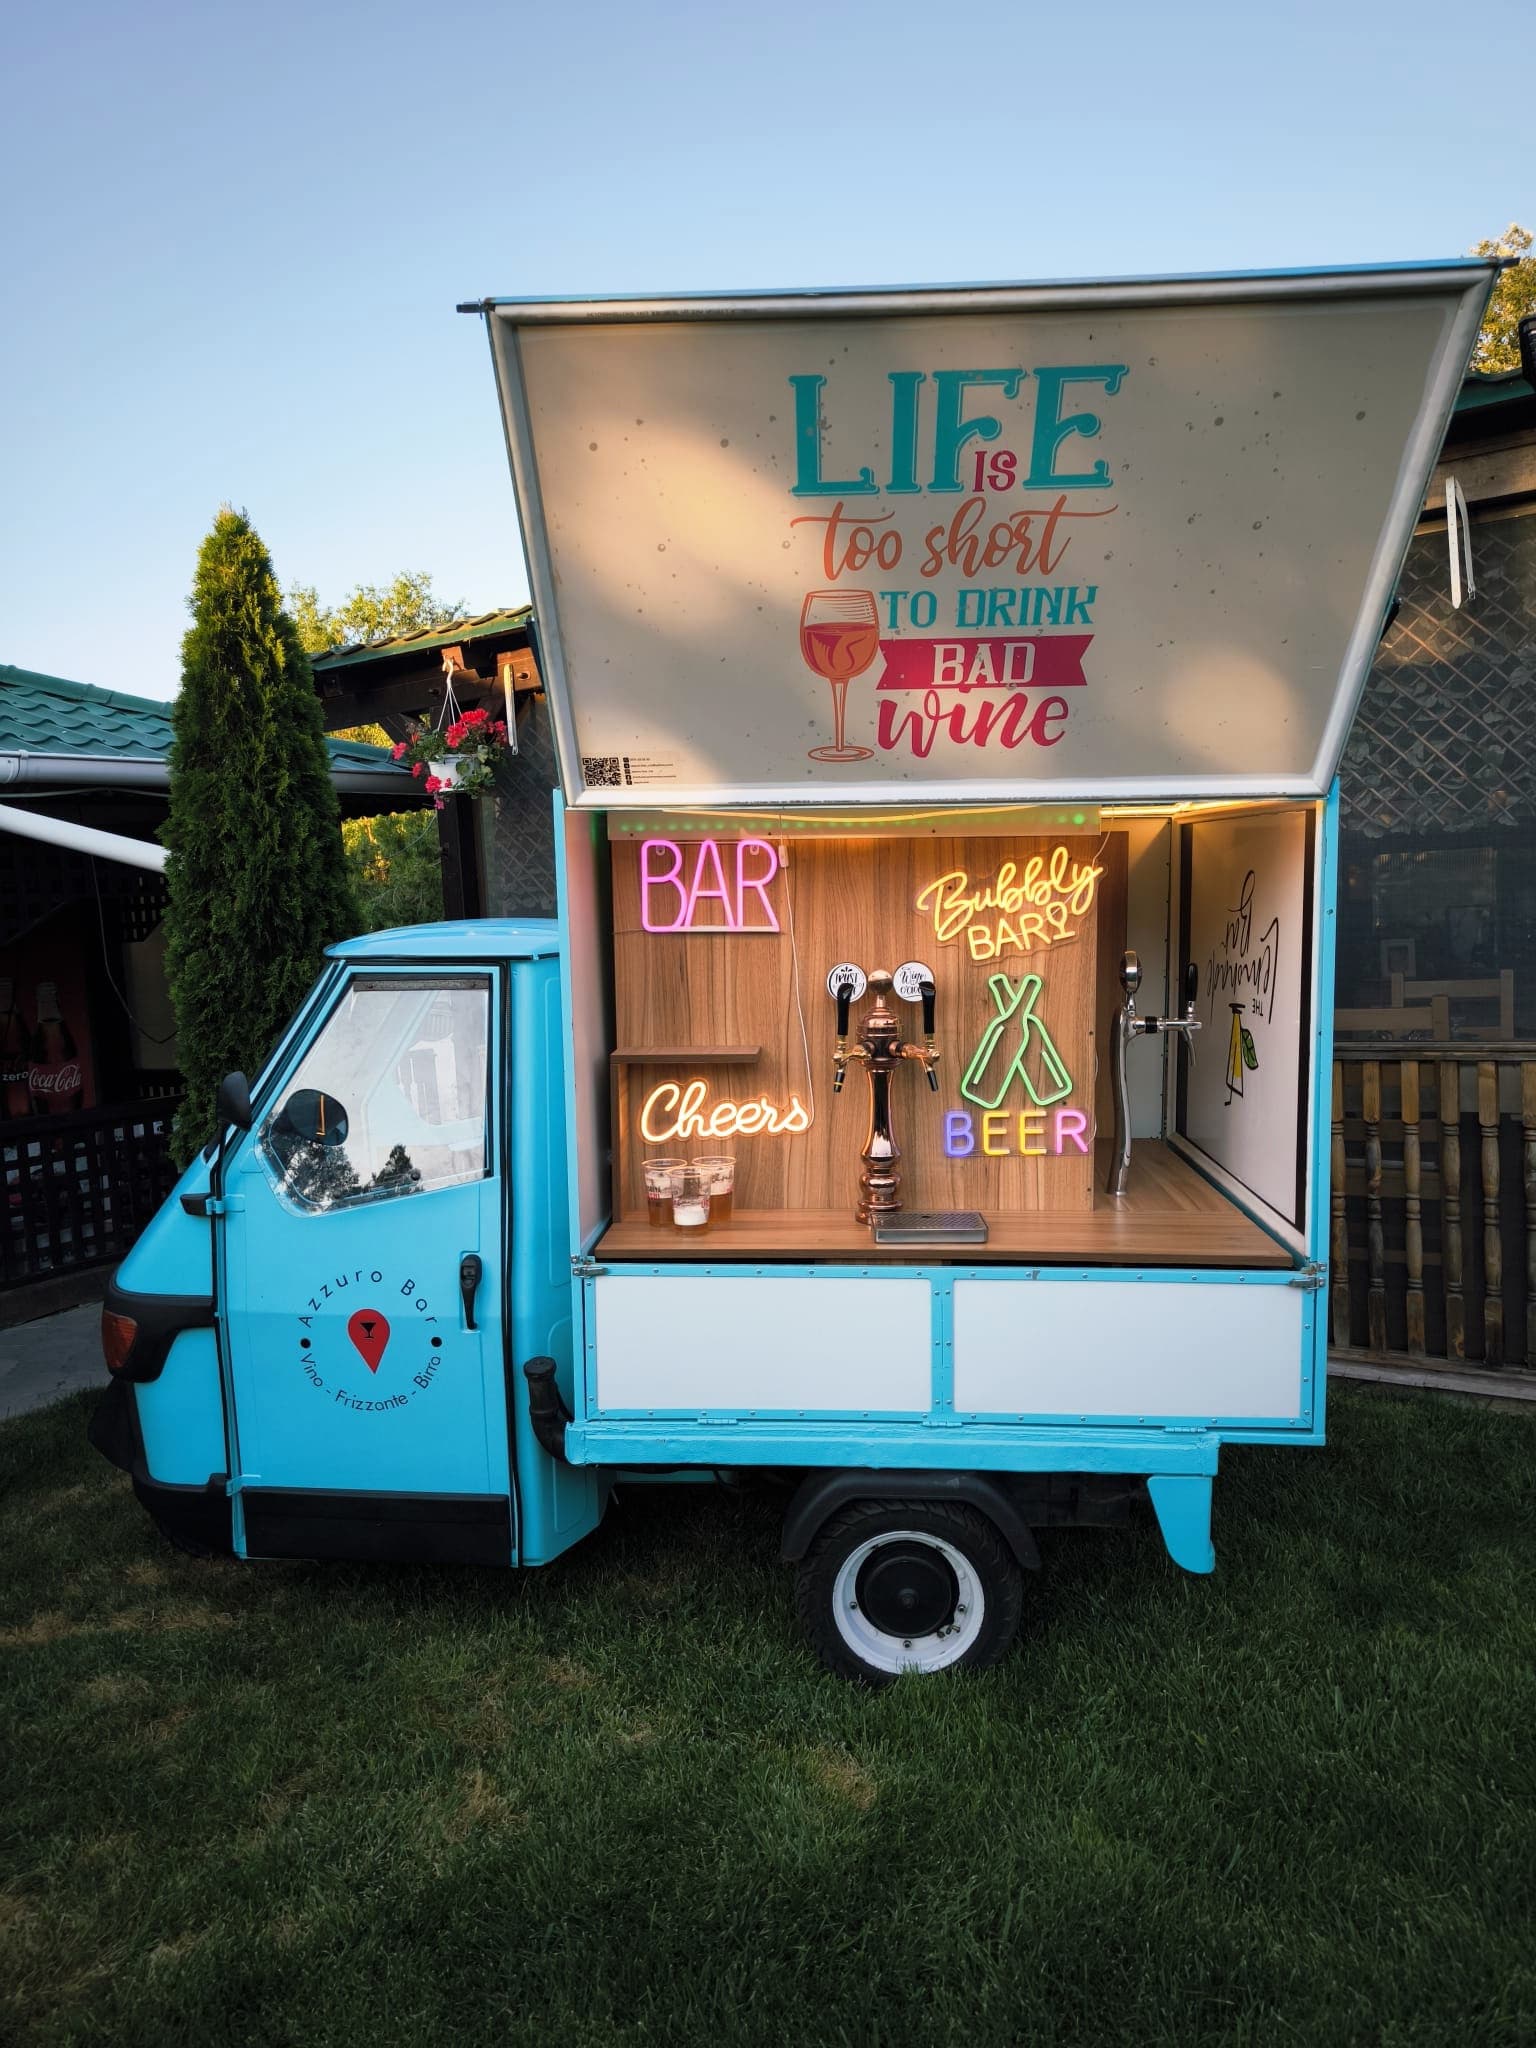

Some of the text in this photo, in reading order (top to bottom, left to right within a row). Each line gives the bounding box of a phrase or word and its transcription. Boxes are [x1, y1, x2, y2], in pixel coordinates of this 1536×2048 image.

[788, 364, 1130, 496] LIFE
[972, 450, 1018, 492] IS
[790, 494, 1119, 580] too short
[880, 585, 1099, 629] TO DRINK
[931, 642, 1036, 686] BAD
[876, 685, 1069, 758] wine
[640, 839, 781, 933] BAR
[916, 846, 1103, 942] Bubbly
[966, 911, 1052, 961] BAR
[1206, 917, 1279, 1025] Lemonade
[1251, 998, 1264, 1017] THE
[2, 1072, 29, 1082] zero
[639, 1080, 812, 1144] Cheers
[944, 1109, 1088, 1157] BEER
[298, 1269, 438, 1329] Azzuro Bar
[300, 1352, 324, 1387] Vino
[335, 1389, 409, 1412] Frizzante
